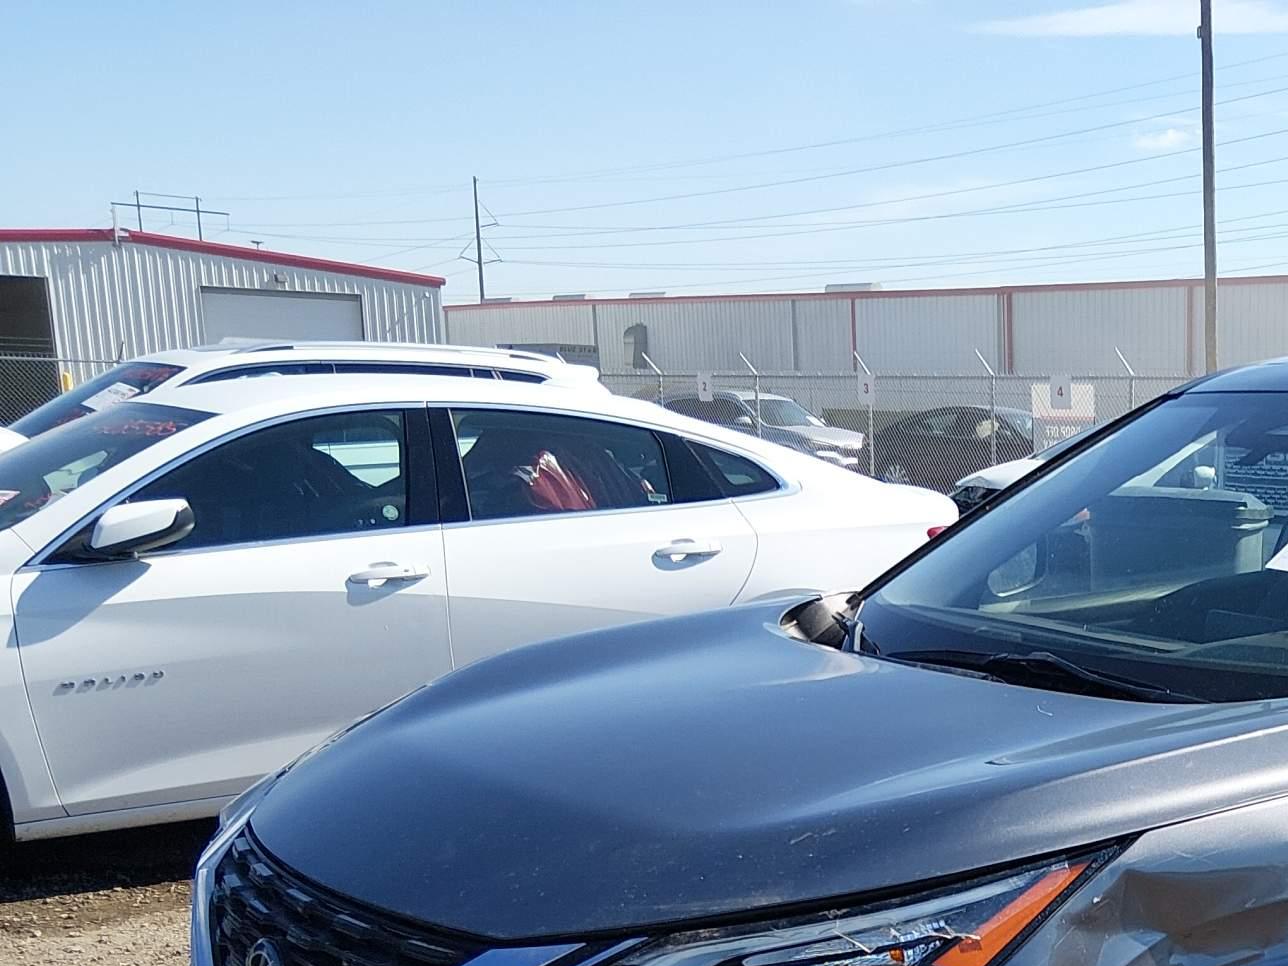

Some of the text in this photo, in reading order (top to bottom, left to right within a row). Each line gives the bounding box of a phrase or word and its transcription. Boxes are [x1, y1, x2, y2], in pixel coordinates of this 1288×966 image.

[701, 382, 708, 392] 2
[863, 383, 870, 394] 3
[1056, 386, 1064, 397] 4
